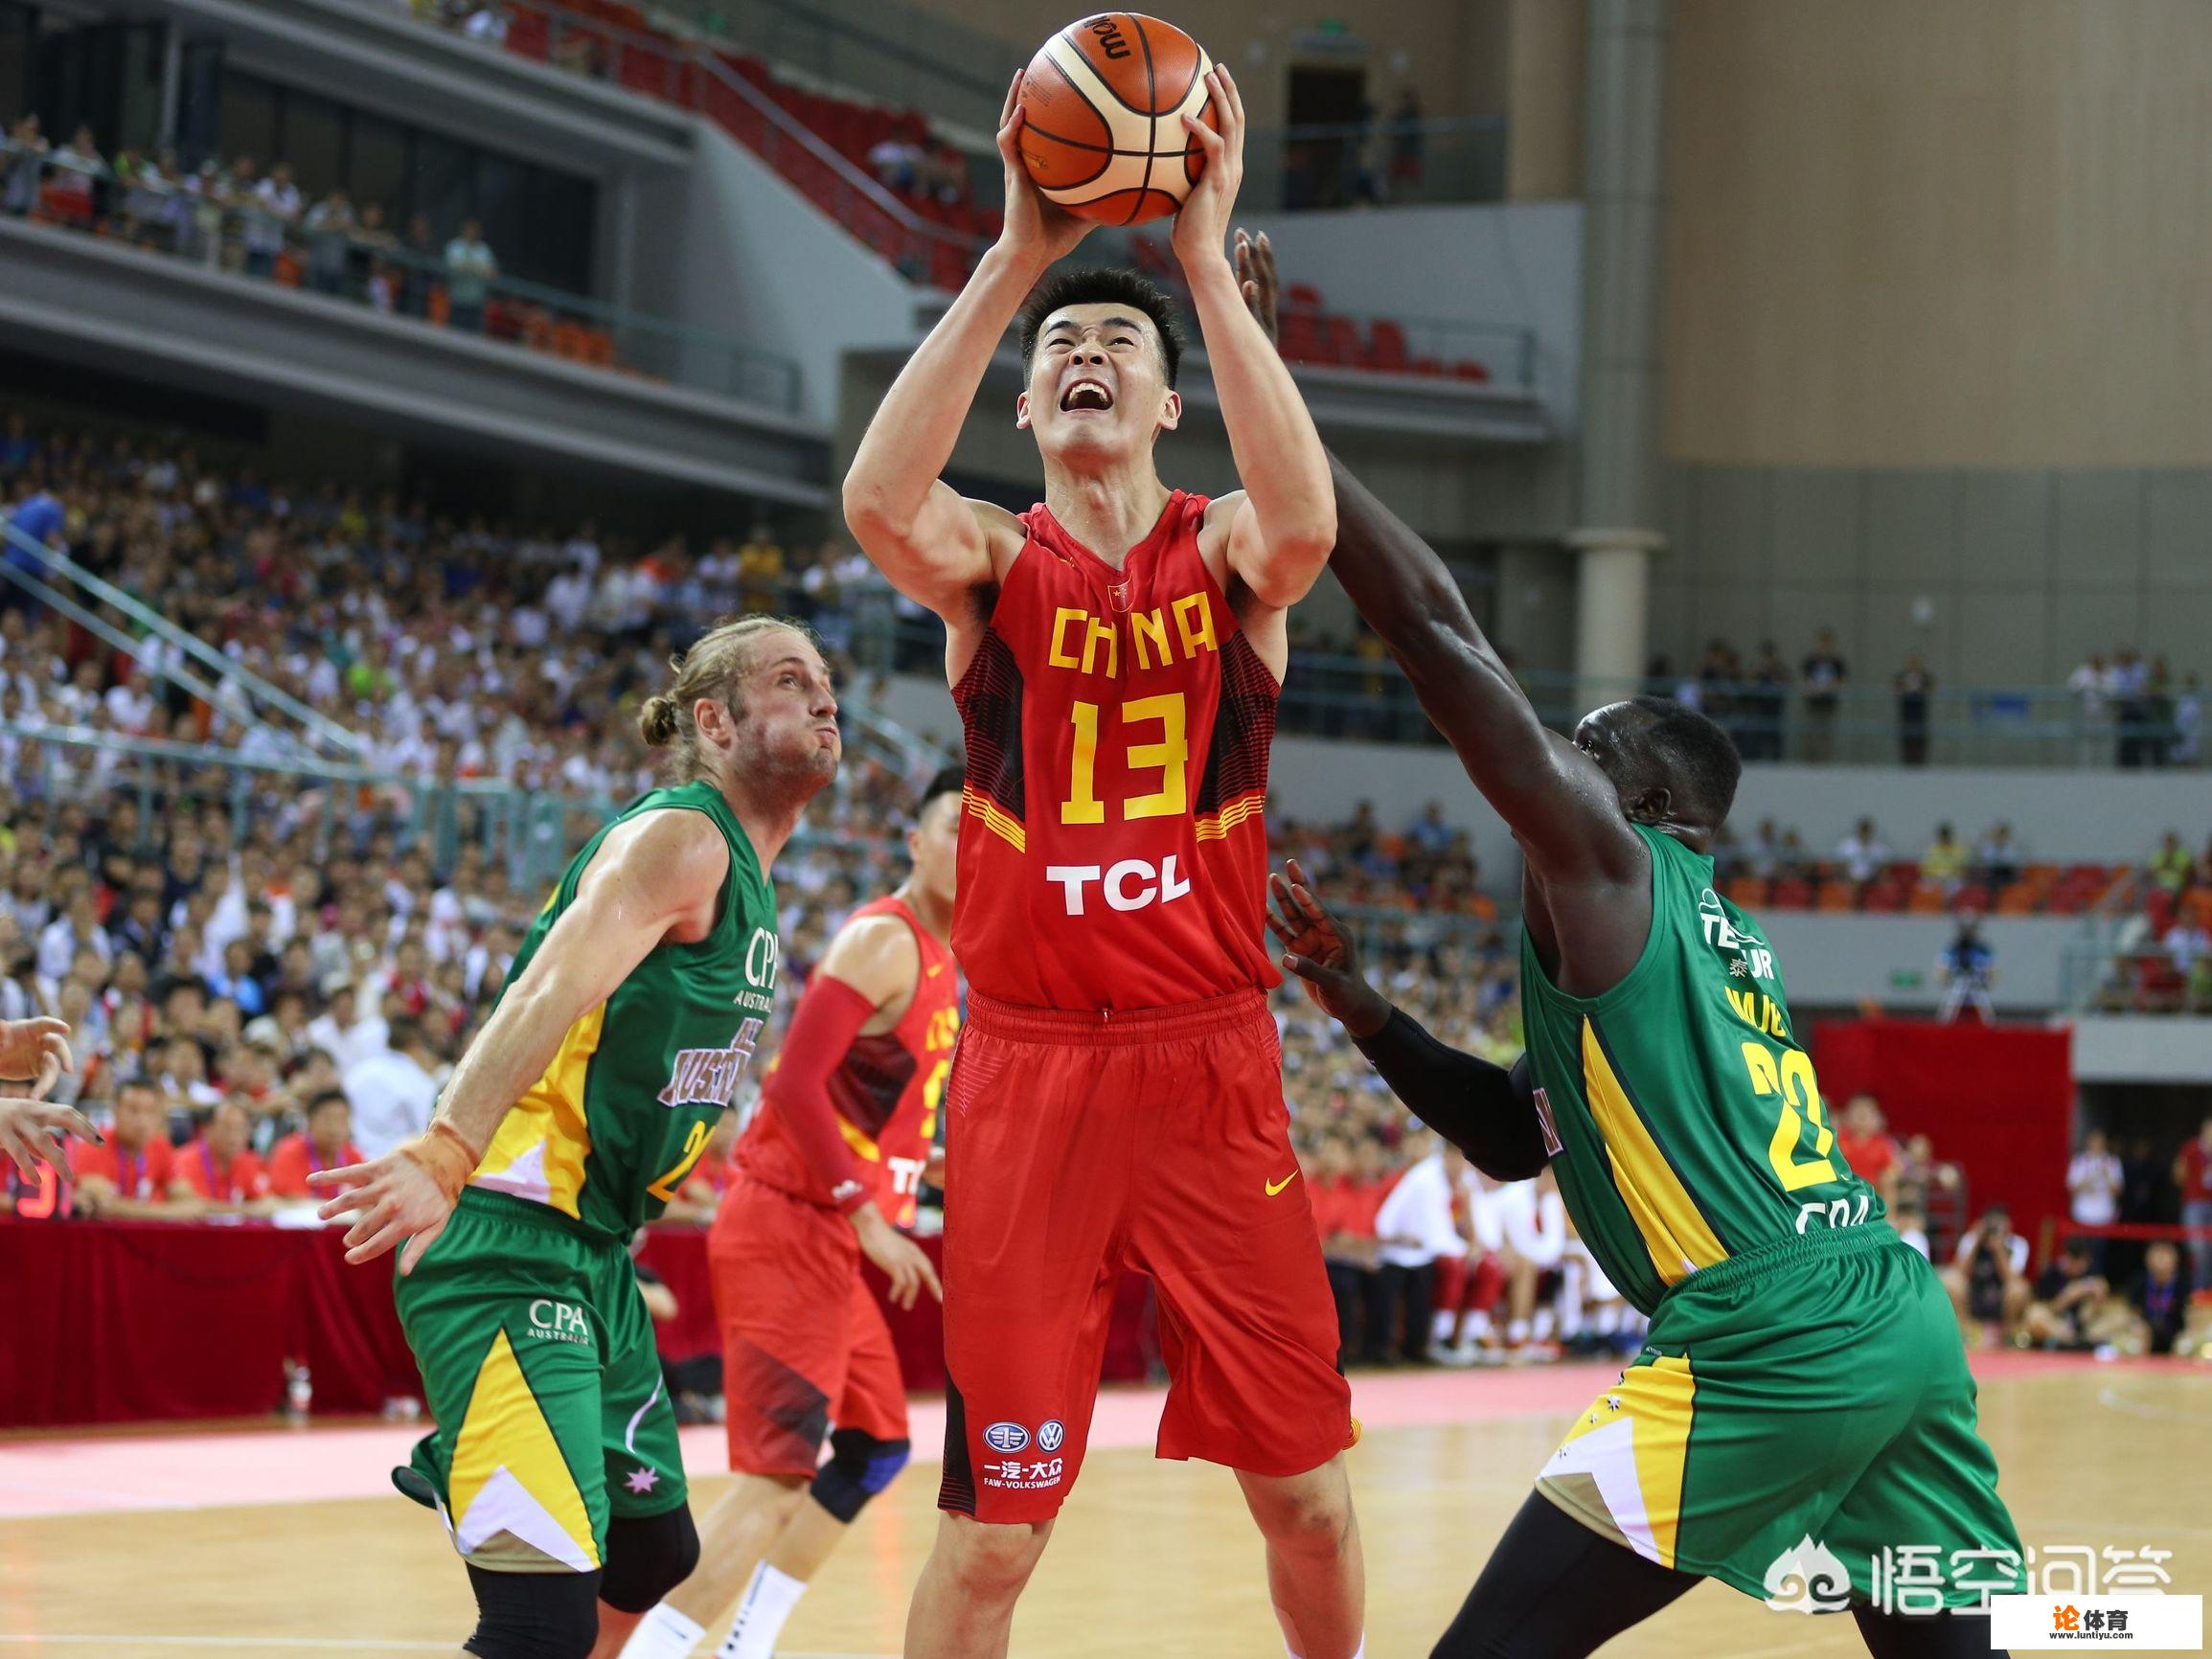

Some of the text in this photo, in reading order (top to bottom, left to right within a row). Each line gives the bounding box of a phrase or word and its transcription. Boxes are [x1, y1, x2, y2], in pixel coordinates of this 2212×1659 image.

[1048, 591, 1218, 679] CHNA
[1060, 692, 1188, 825] 13
[1046, 854, 1191, 916] TCL
[529, 1298, 588, 1336] CPA
[983, 1476, 1060, 1489] FAW-VOLKSWAGEN
